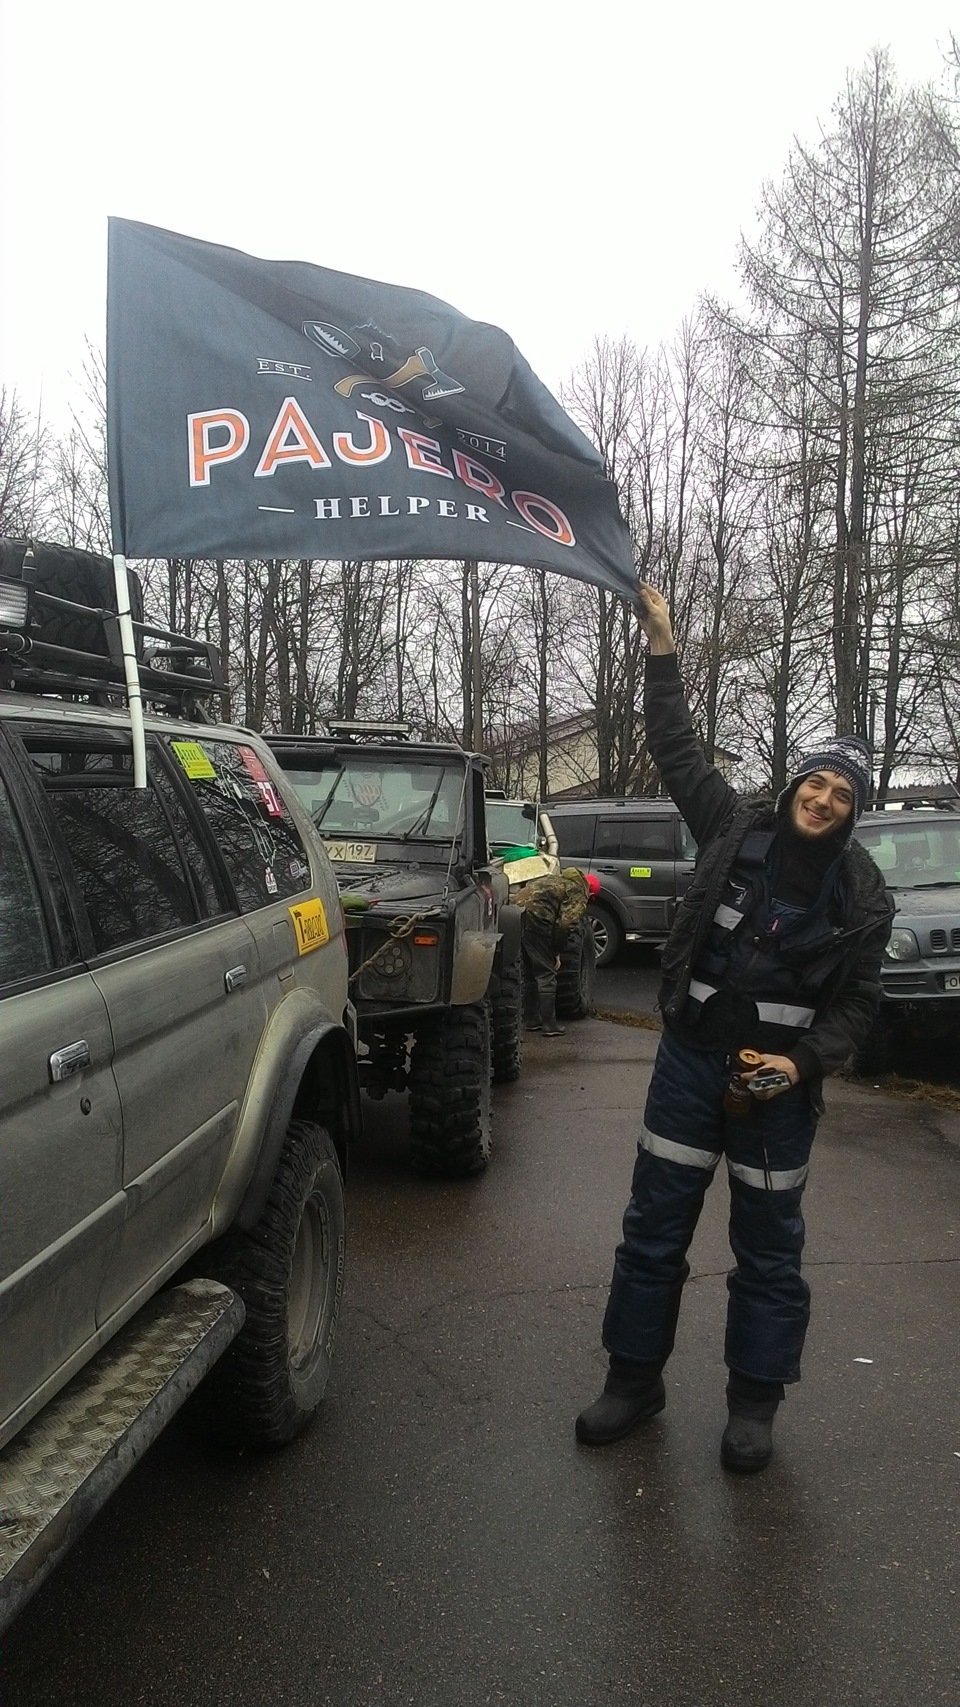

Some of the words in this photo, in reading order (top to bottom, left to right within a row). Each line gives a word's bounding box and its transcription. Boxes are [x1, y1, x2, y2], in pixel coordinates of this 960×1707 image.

[257, 360, 312, 379] EST.
[457, 431, 507, 459] 2014
[187, 397, 577, 548] PAJERO
[313, 495, 490, 523] HELPER
[348, 844, 372, 857] 197
